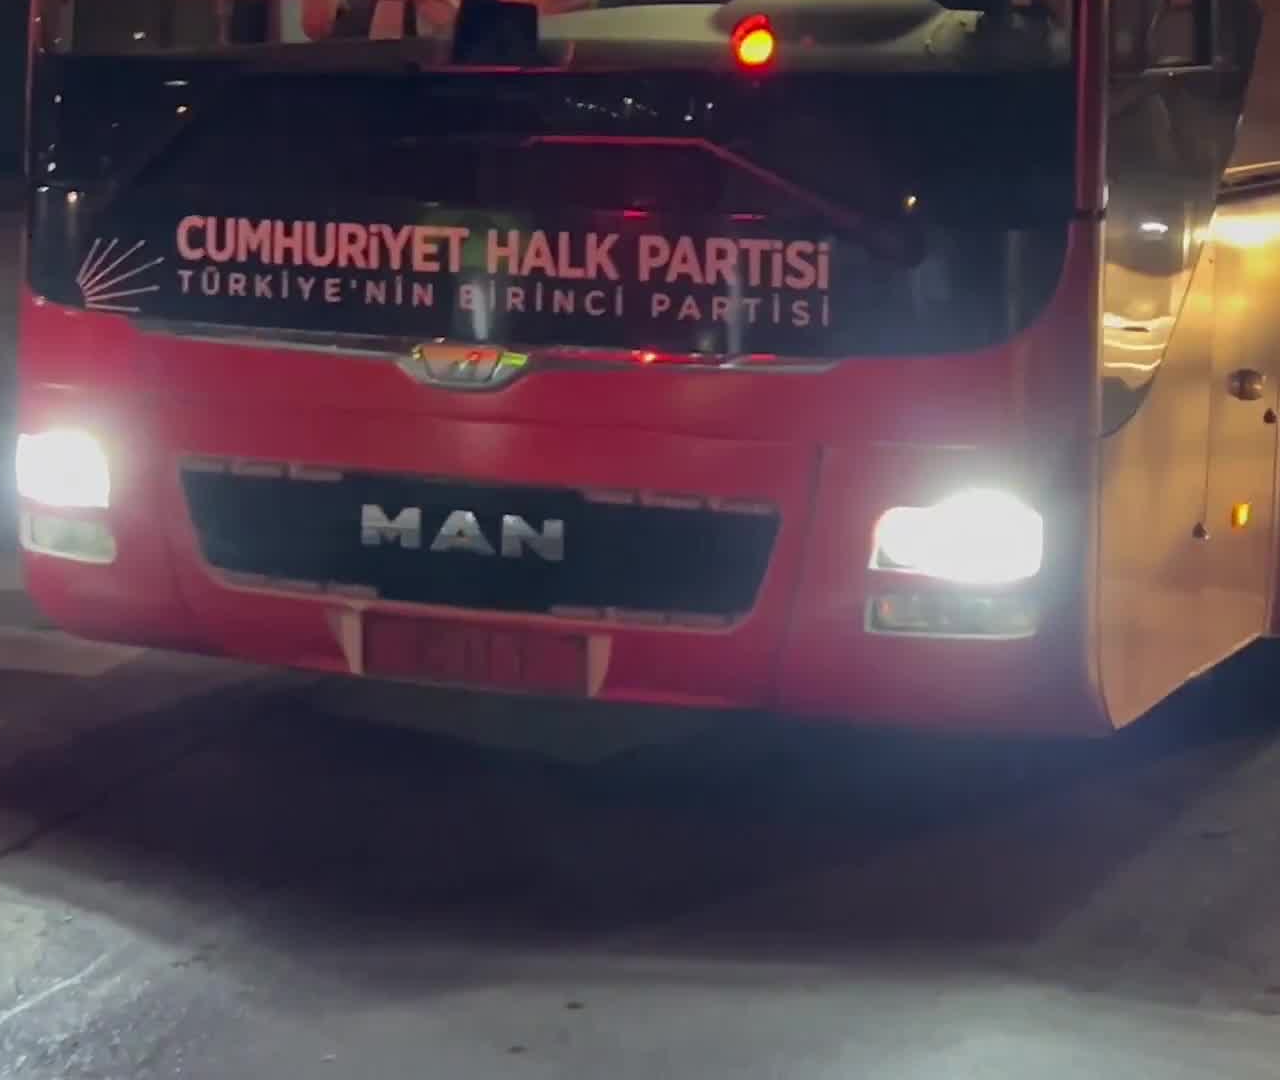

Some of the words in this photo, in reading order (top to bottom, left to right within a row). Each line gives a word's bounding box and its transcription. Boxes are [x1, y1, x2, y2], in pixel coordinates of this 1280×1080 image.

[176, 214, 469, 273] CUMHURİYET
[486, 228, 621, 281] HALK
[637, 234, 830, 290] PARTİSİ
[176, 265, 434, 308] TÜRKİYE'NİN
[458, 279, 624, 317] BİRİNCİ
[650, 292, 830, 327] PARTİSİ
[360, 503, 564, 561] MAN
